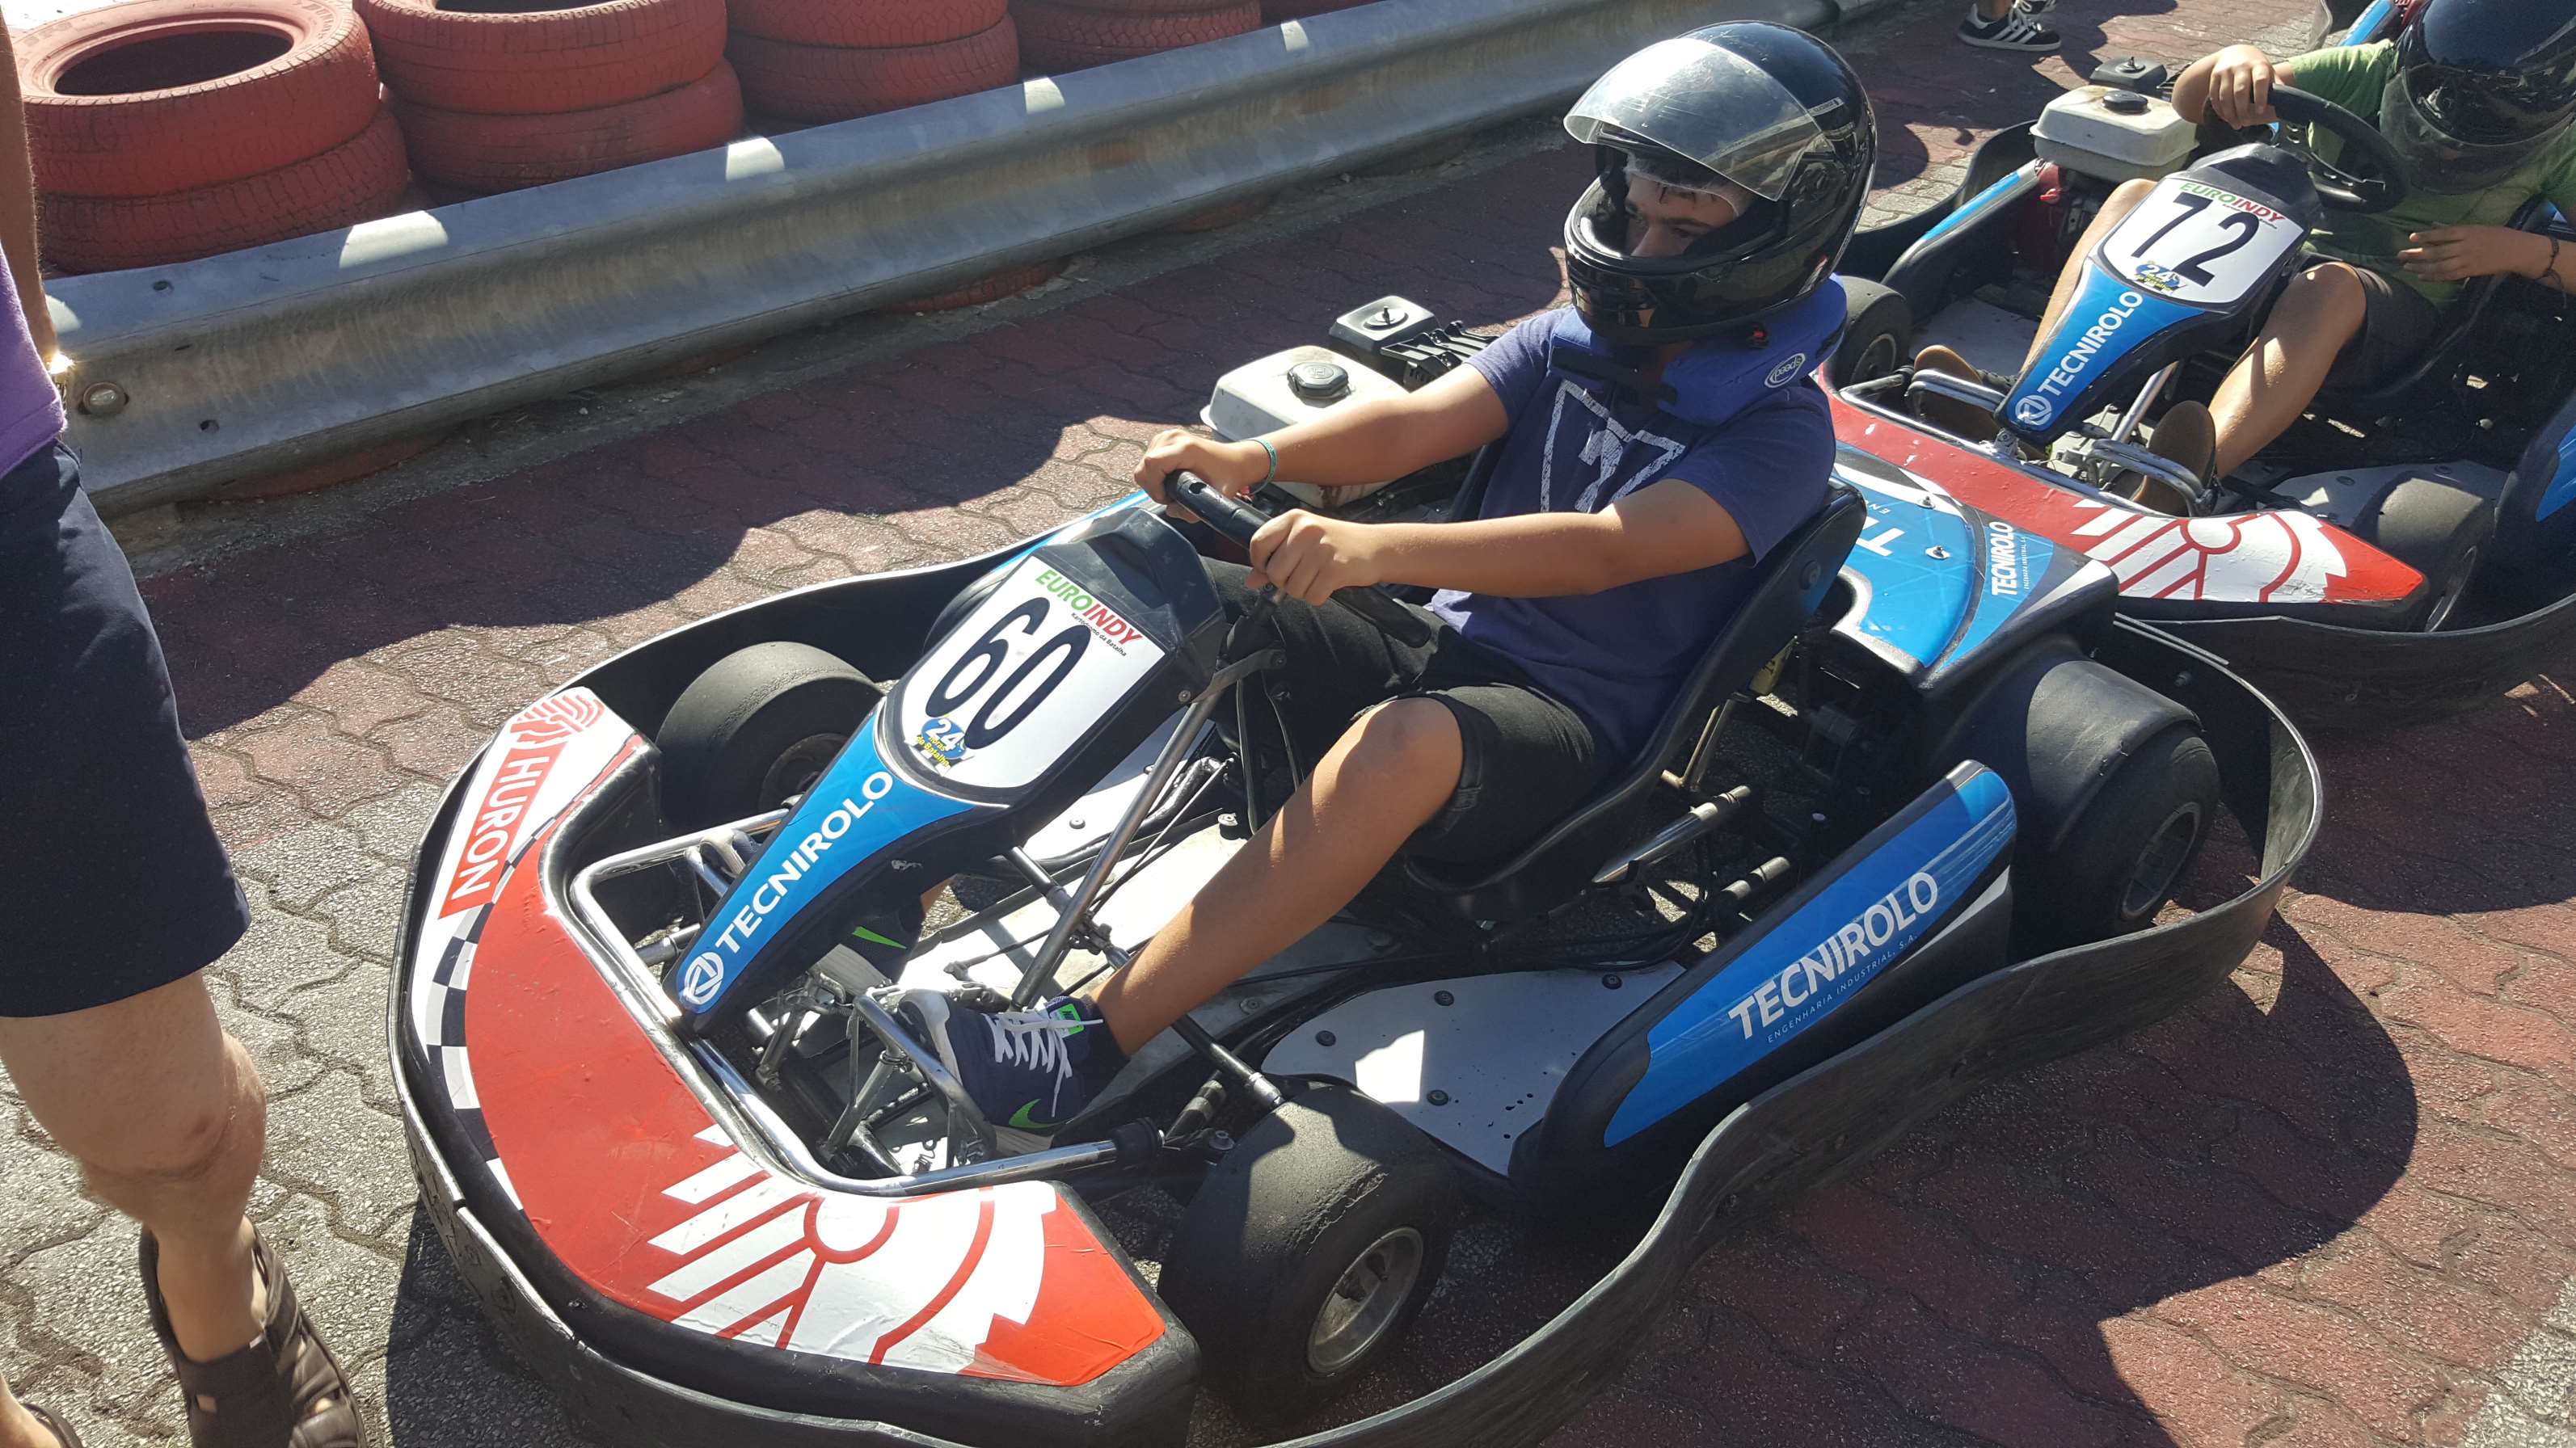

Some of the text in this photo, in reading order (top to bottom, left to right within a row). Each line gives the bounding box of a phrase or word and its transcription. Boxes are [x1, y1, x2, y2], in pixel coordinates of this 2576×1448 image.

[2131, 192, 2259, 287] 72
[2179, 183, 2285, 222] EUROINDY
[2140, 264, 2177, 283] 24
[2037, 292, 2143, 396] TECNIROLO
[1035, 569, 1143, 645] EUROINDY
[1988, 521, 2017, 596] TECNIROLO
[925, 597, 1091, 749] 60
[925, 718, 965, 751] 24
[452, 756, 550, 900] HURON
[715, 771, 893, 953] TECNIROLO
[1728, 872, 1937, 1040] TECNIROLO
[1767, 995, 1832, 1043] ENGENHARIA
[1899, 934, 1916, 949] S.A.
